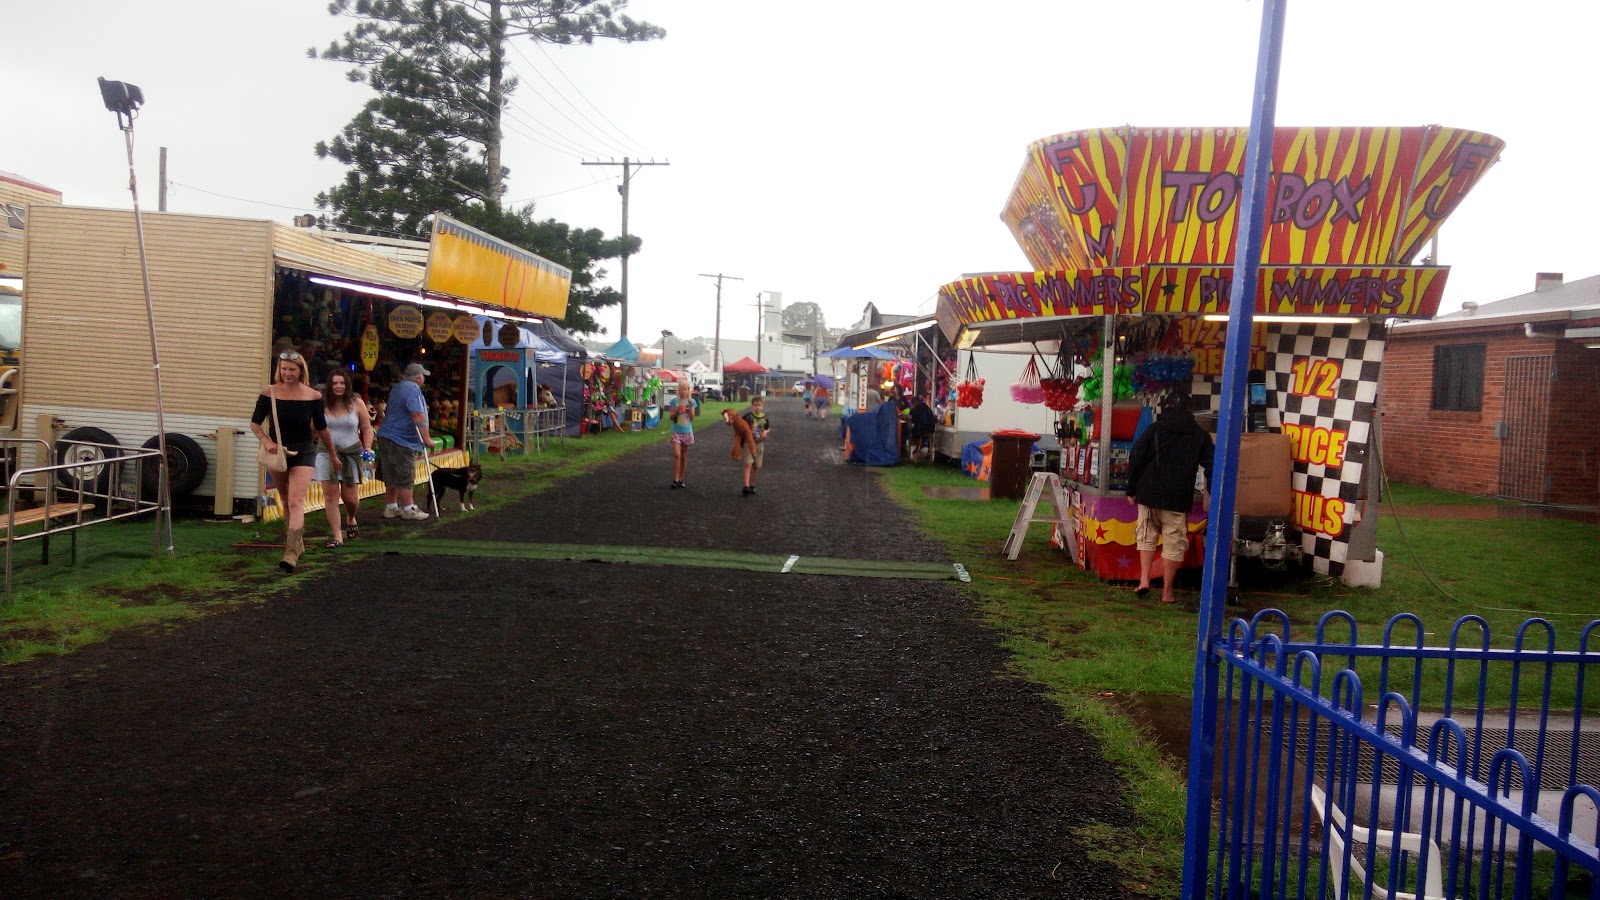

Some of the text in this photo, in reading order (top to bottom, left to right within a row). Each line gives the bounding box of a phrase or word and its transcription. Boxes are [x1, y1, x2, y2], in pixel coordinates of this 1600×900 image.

[1044, 137, 1113, 260] FUN
[1162, 171, 1371, 231] TO BOX
[1034, 275, 1142, 309] WINNERS
[1271, 275, 1406, 308] WINNERS
[480, 351, 519, 362] TICKETS
[1292, 359, 1340, 398] 1/2
[1281, 422, 1347, 468] RICE
[1292, 490, 1346, 537] ILLS
